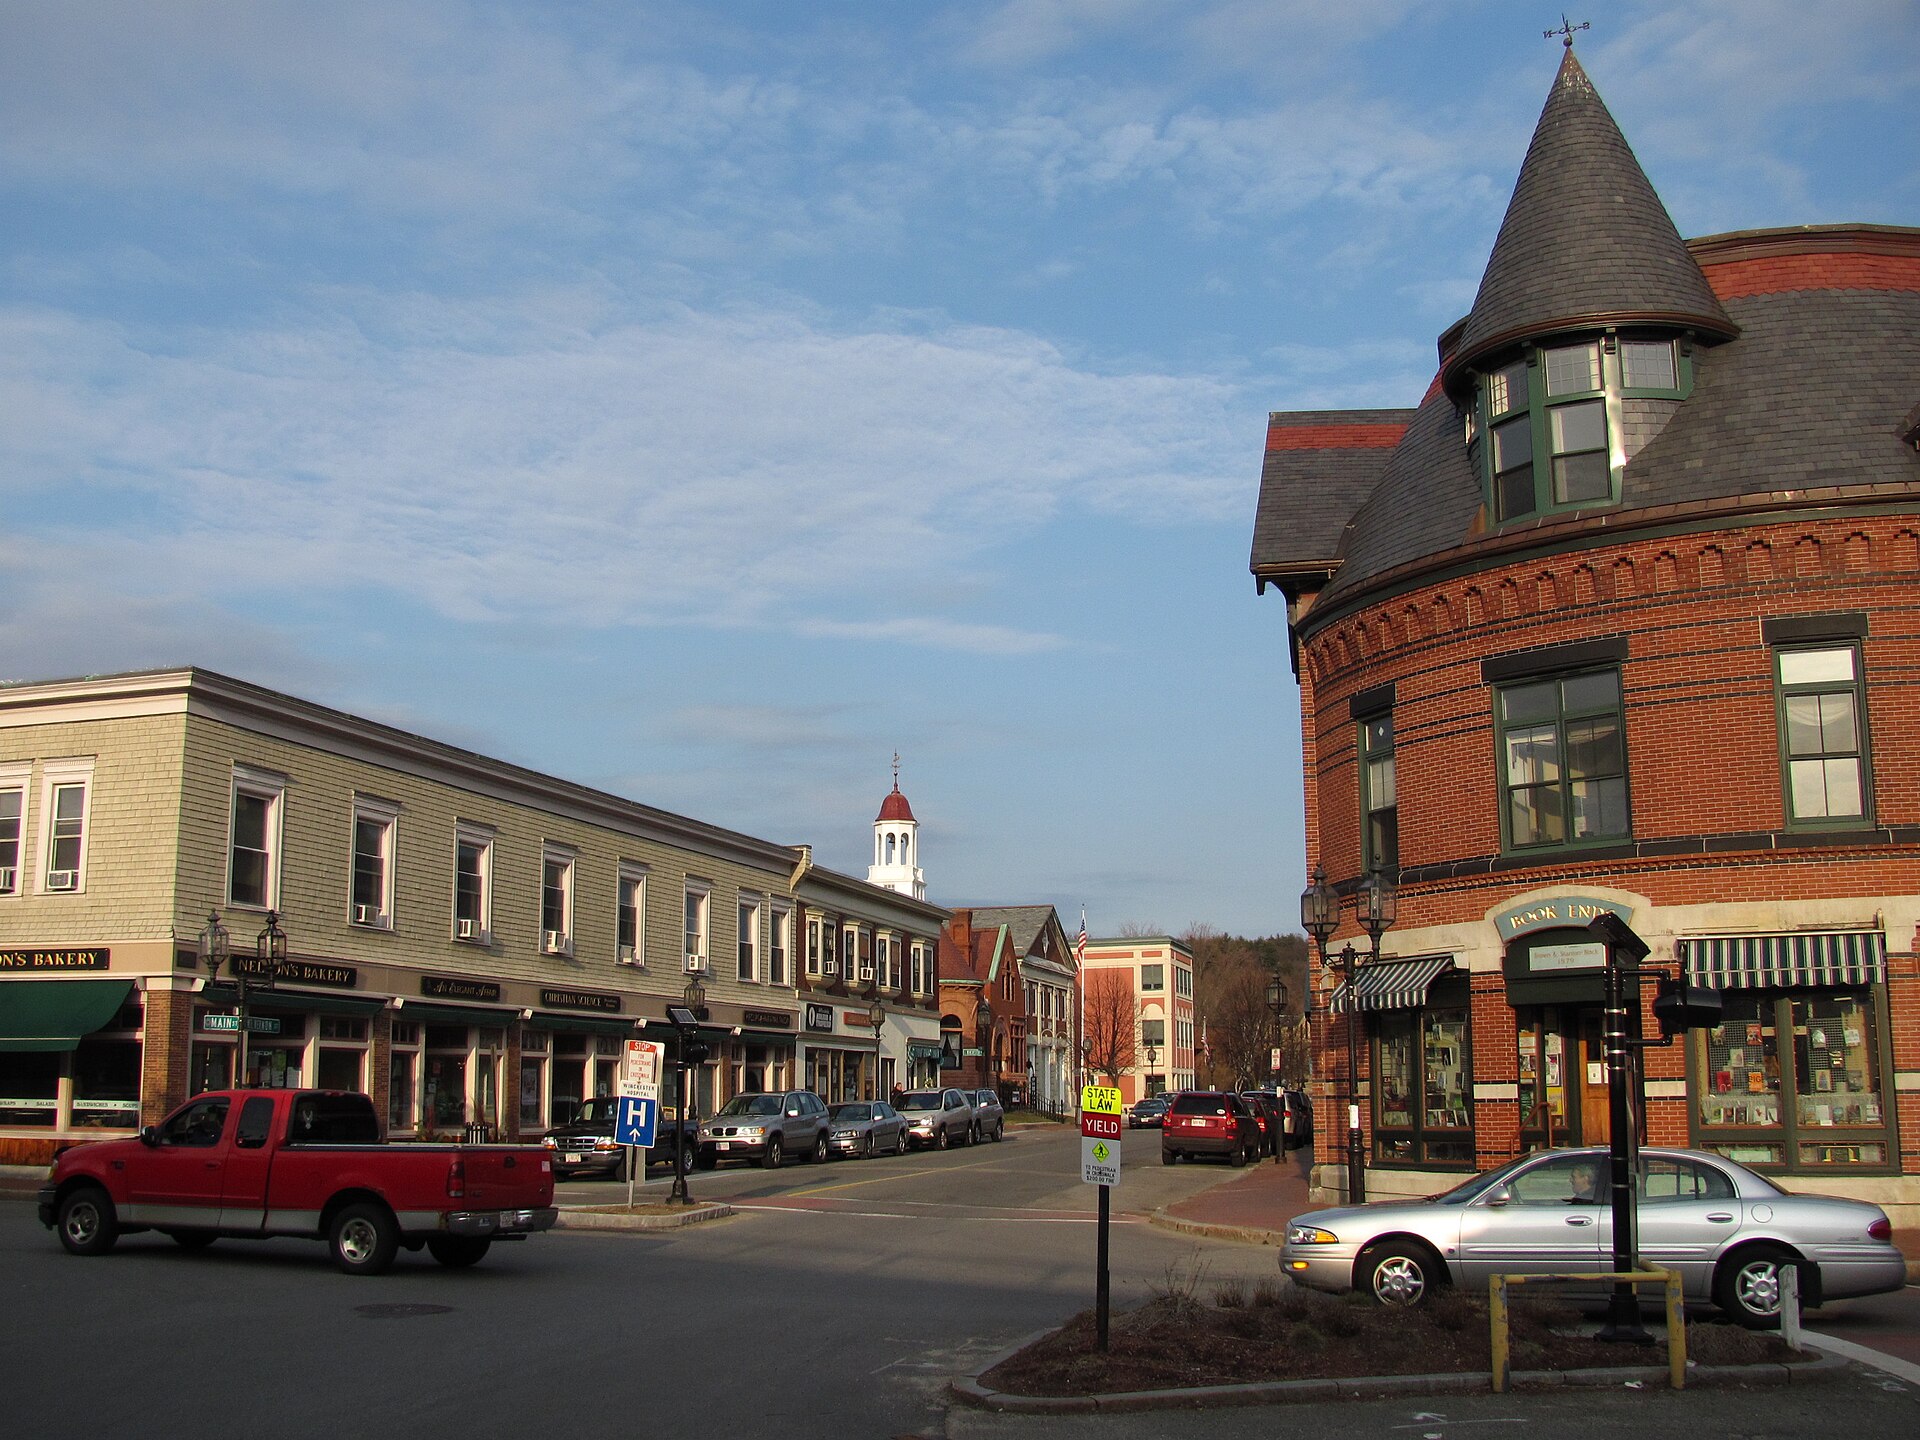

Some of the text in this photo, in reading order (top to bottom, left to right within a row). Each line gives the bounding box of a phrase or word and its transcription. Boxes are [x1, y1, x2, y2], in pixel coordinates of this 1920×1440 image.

[1510, 905, 1559, 929] BOOK
[34, 951, 98, 966] BAKERY
[239, 960, 351, 983] NELN'S BAKERY
[210, 1017, 232, 1029] MAIN
[634, 1041, 651, 1051] STOP
[1087, 1088, 1116, 1100] STATE
[1090, 1099, 1113, 1111] LAW
[627, 1100, 647, 1127] H
[1086, 1119, 1118, 1134] YIELD
